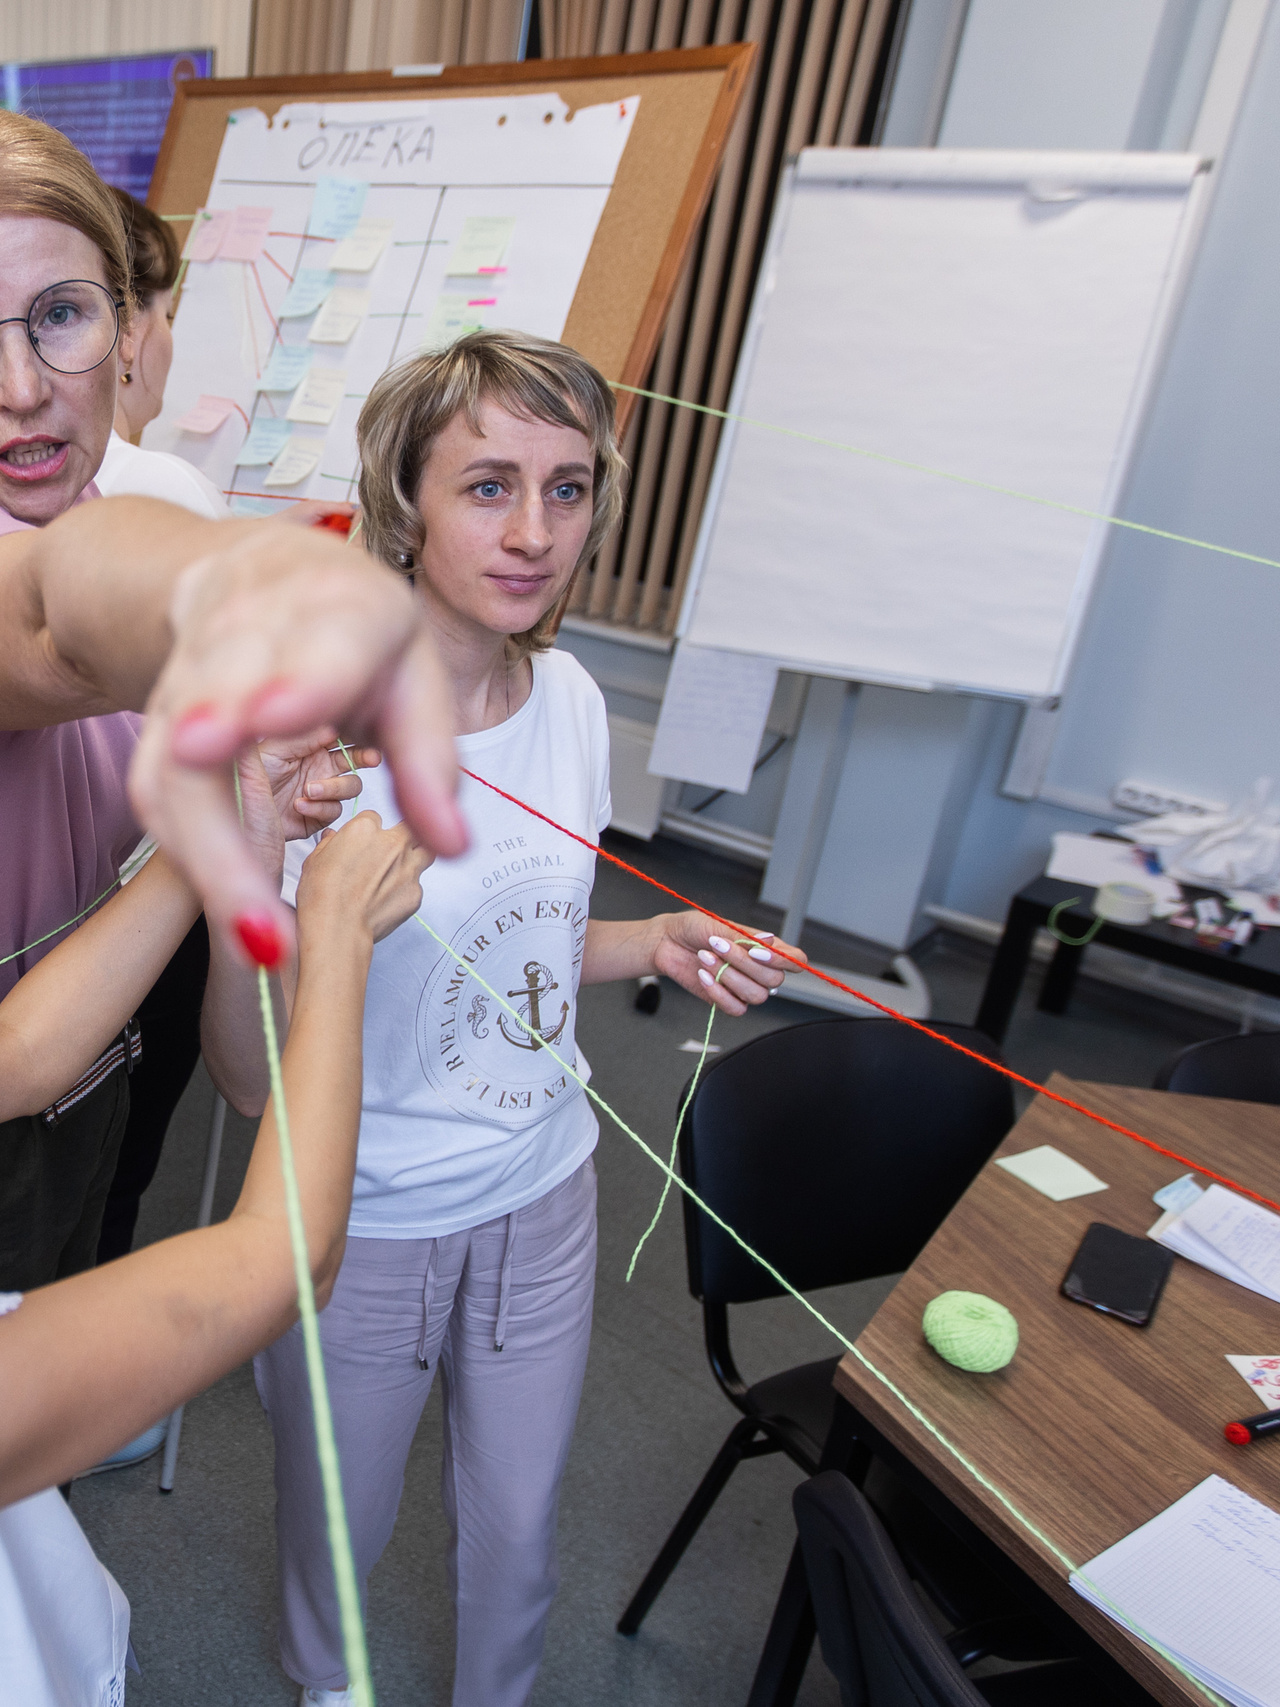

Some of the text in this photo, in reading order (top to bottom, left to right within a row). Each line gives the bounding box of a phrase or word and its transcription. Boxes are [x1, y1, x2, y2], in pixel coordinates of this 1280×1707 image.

[298, 125, 435, 170] ОПЕКА
[493, 836, 527, 853] THE
[482, 855, 564, 889] ORIGINAL
[494, 906, 524, 934] EN
[535, 900, 574, 920] EST
[494, 1090, 532, 1109] EST
